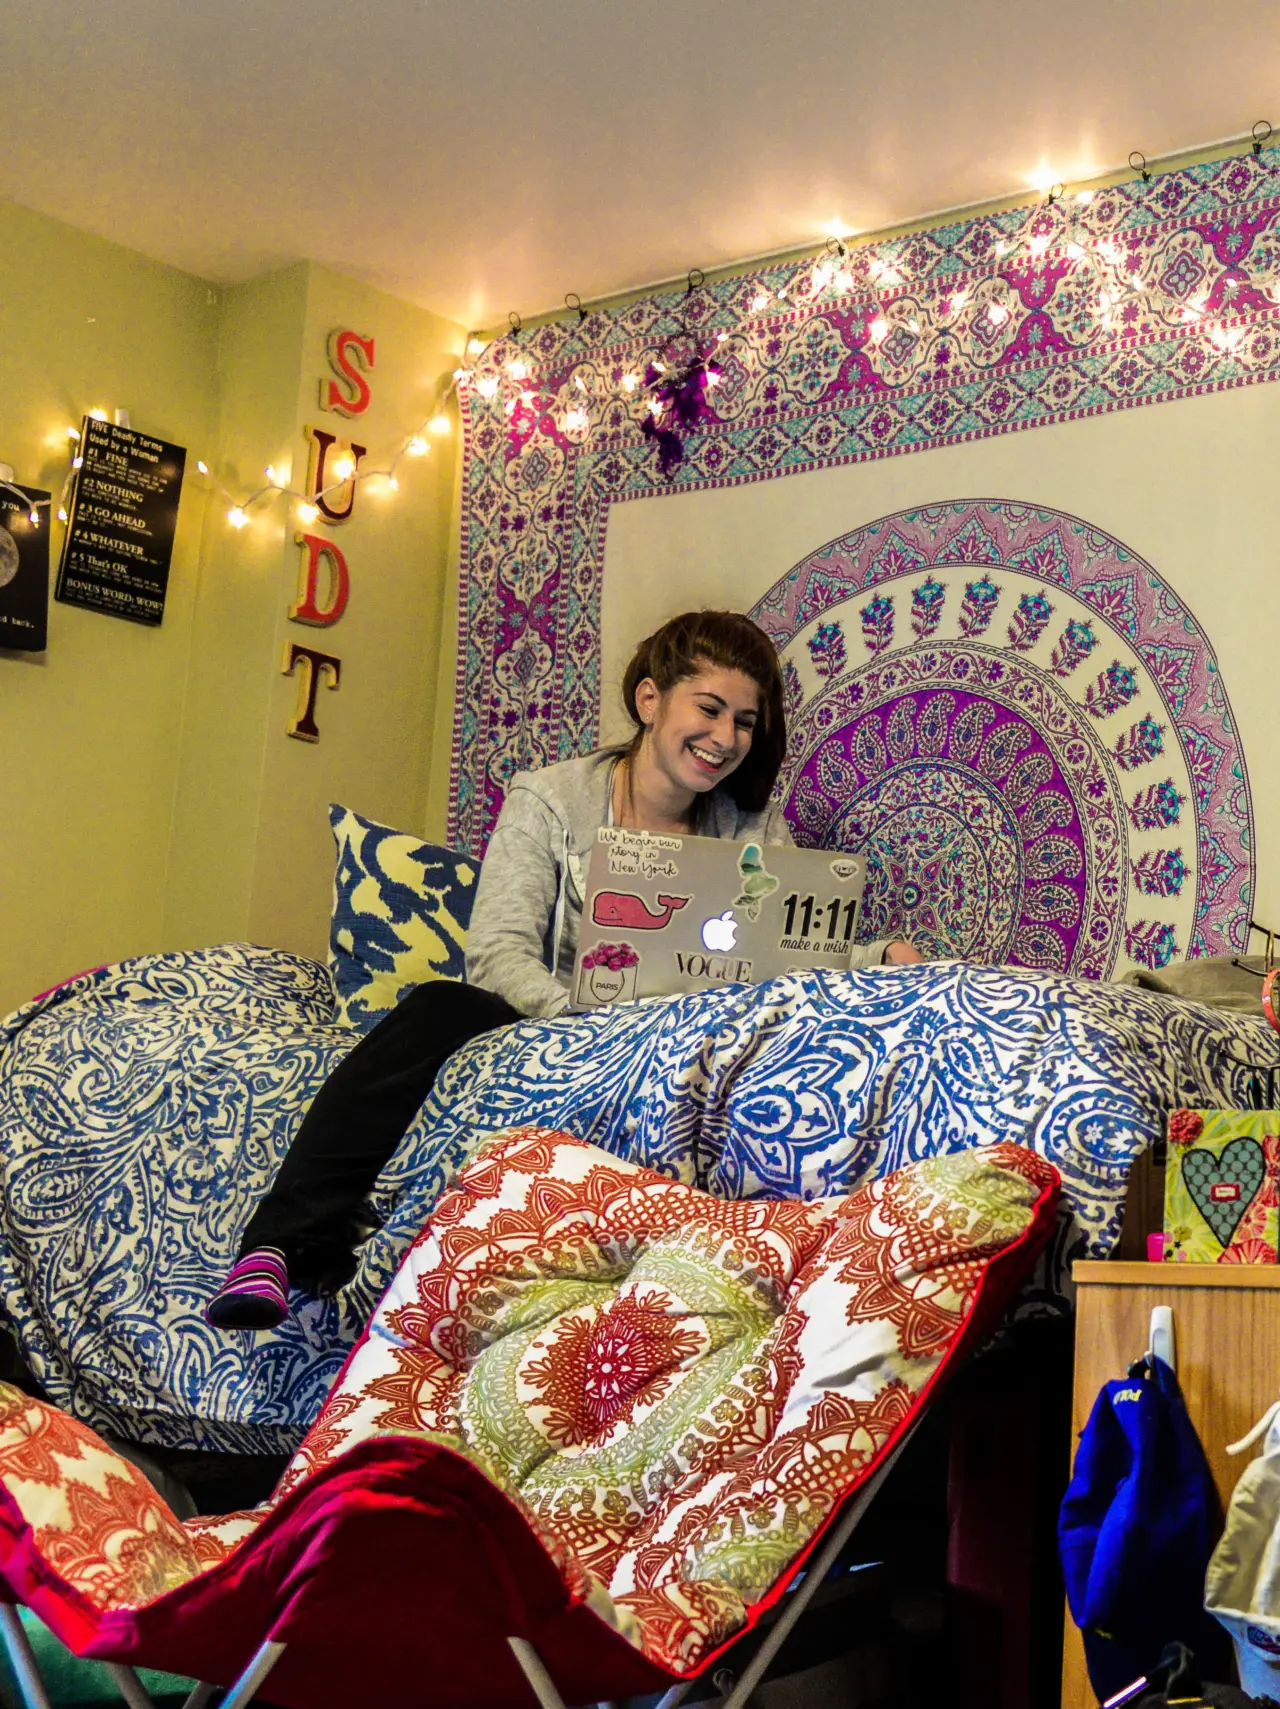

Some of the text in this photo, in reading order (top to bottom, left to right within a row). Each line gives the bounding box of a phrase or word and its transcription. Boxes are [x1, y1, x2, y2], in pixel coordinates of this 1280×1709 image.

[91, 420, 163, 453] FIVE Deadly Terms
[89, 433, 159, 464] Used by a Woman
[105, 451, 129, 467] FINE
[83, 477, 95, 488] #2
[96, 480, 144, 503] NOTHING
[94, 505, 111, 519] GO
[112, 512, 146, 529] AHEAD
[90, 532, 144, 556] WHATEVER
[87, 554, 111, 570] That's
[112, 561, 128, 574] OK
[66, 578, 100, 594] BONUS
[600, 830, 681, 852] We begin our
[610, 846, 657, 865] story in
[611, 860, 677, 879] New York
[783, 894, 858, 941] 11:11
[780, 937, 849, 955] make a wish
[675, 952, 752, 983] VOGUE
[595, 982, 619, 991] PARIS
